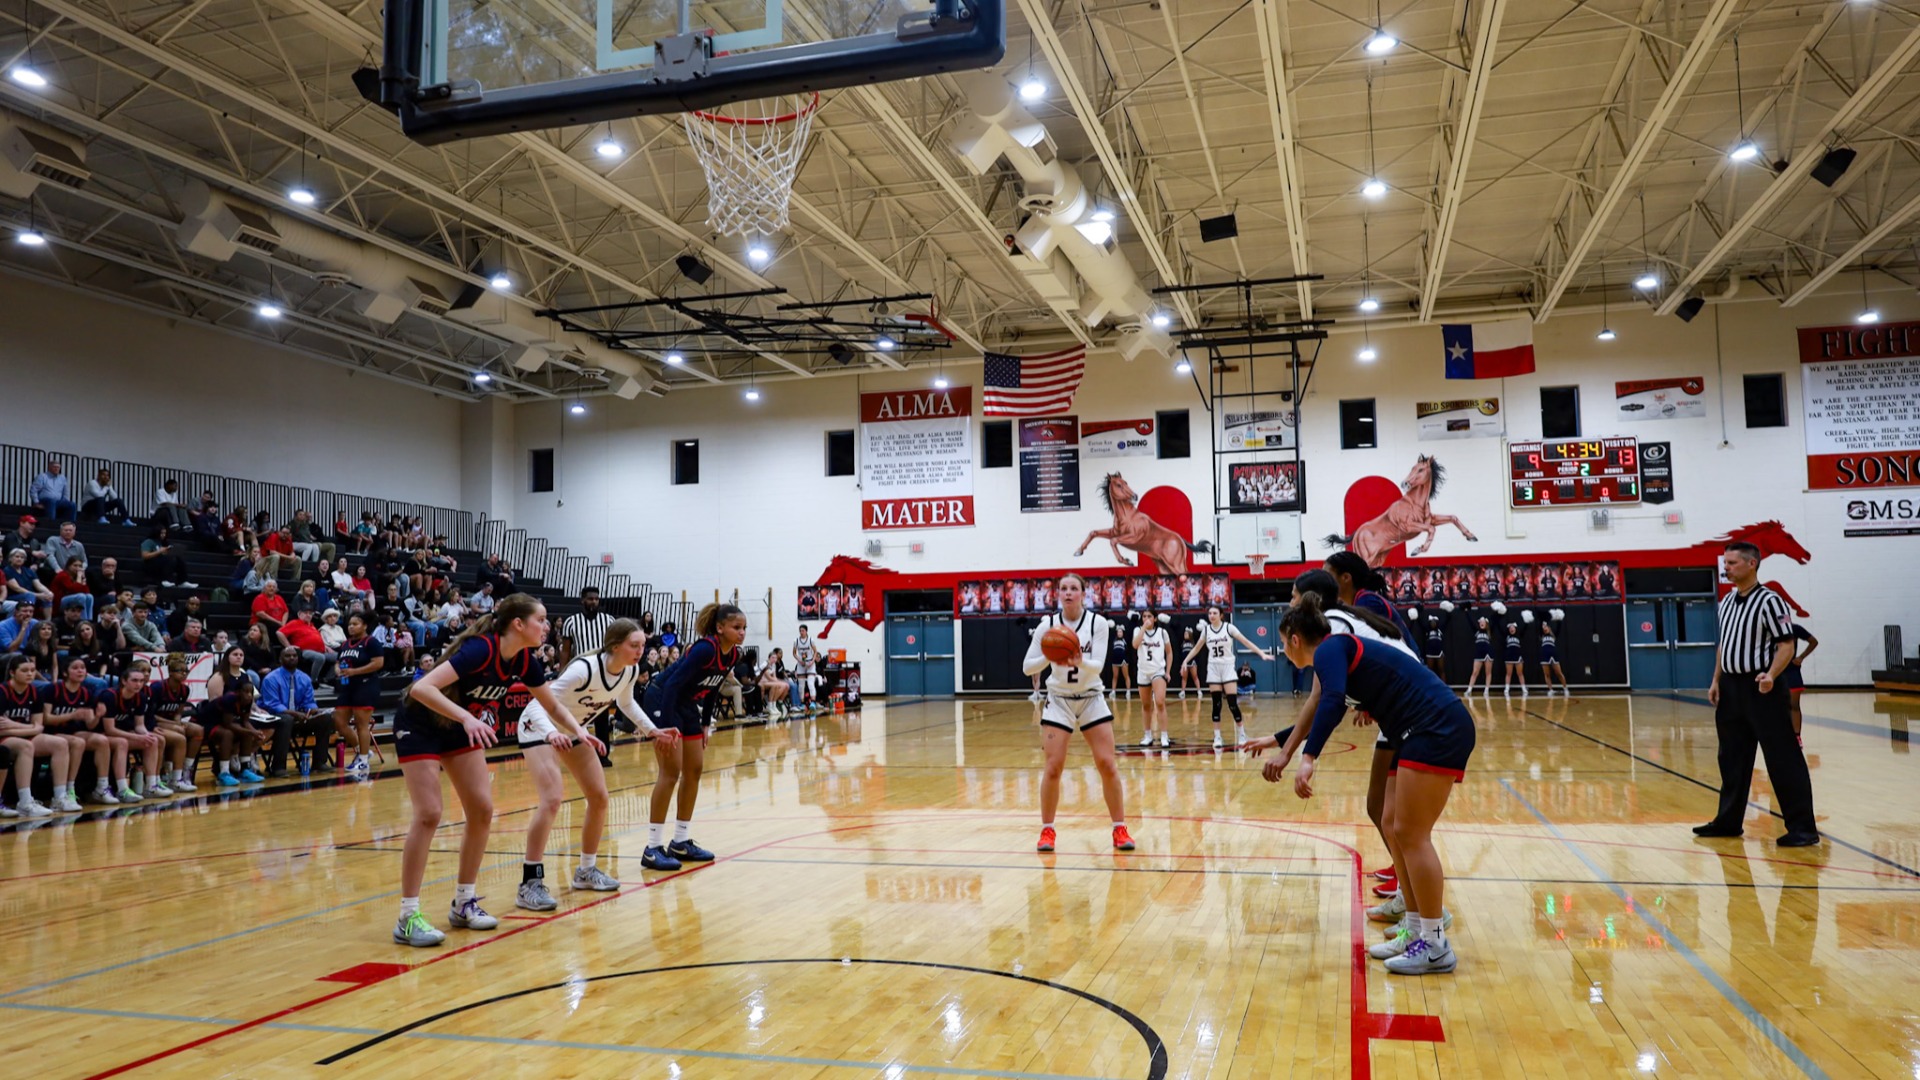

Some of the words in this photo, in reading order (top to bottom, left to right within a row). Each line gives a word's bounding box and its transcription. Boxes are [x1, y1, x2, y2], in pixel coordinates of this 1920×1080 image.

[1826, 377, 1864, 385] MARCHING
[1865, 394, 1906, 402] CREEKVIEW
[876, 392, 956, 418] ALMA
[1421, 402, 1438, 412] GOLD
[1441, 400, 1479, 409] SPONSORS
[1226, 413, 1248, 424] SILVER
[1250, 412, 1282, 420] SPONSORS
[1511, 444, 1540, 452] MUSTANGS
[1605, 439, 1635, 447] VISITOR
[1557, 442, 1600, 458] 4:34
[1528, 454, 1539, 469] 9
[1618, 449, 1634, 465] 13
[1580, 463, 1590, 476] 2
[1524, 487, 1533, 500] 3
[1542, 490, 1549, 499] 0
[1602, 487, 1609, 496] 0
[1632, 482, 1636, 495] 1
[871, 500, 966, 526] MATER
[340, 648, 359, 658] ALLEN
[1147, 651, 1152, 661] 5
[1212, 646, 1224, 657] 35
[1068, 666, 1078, 683] 2
